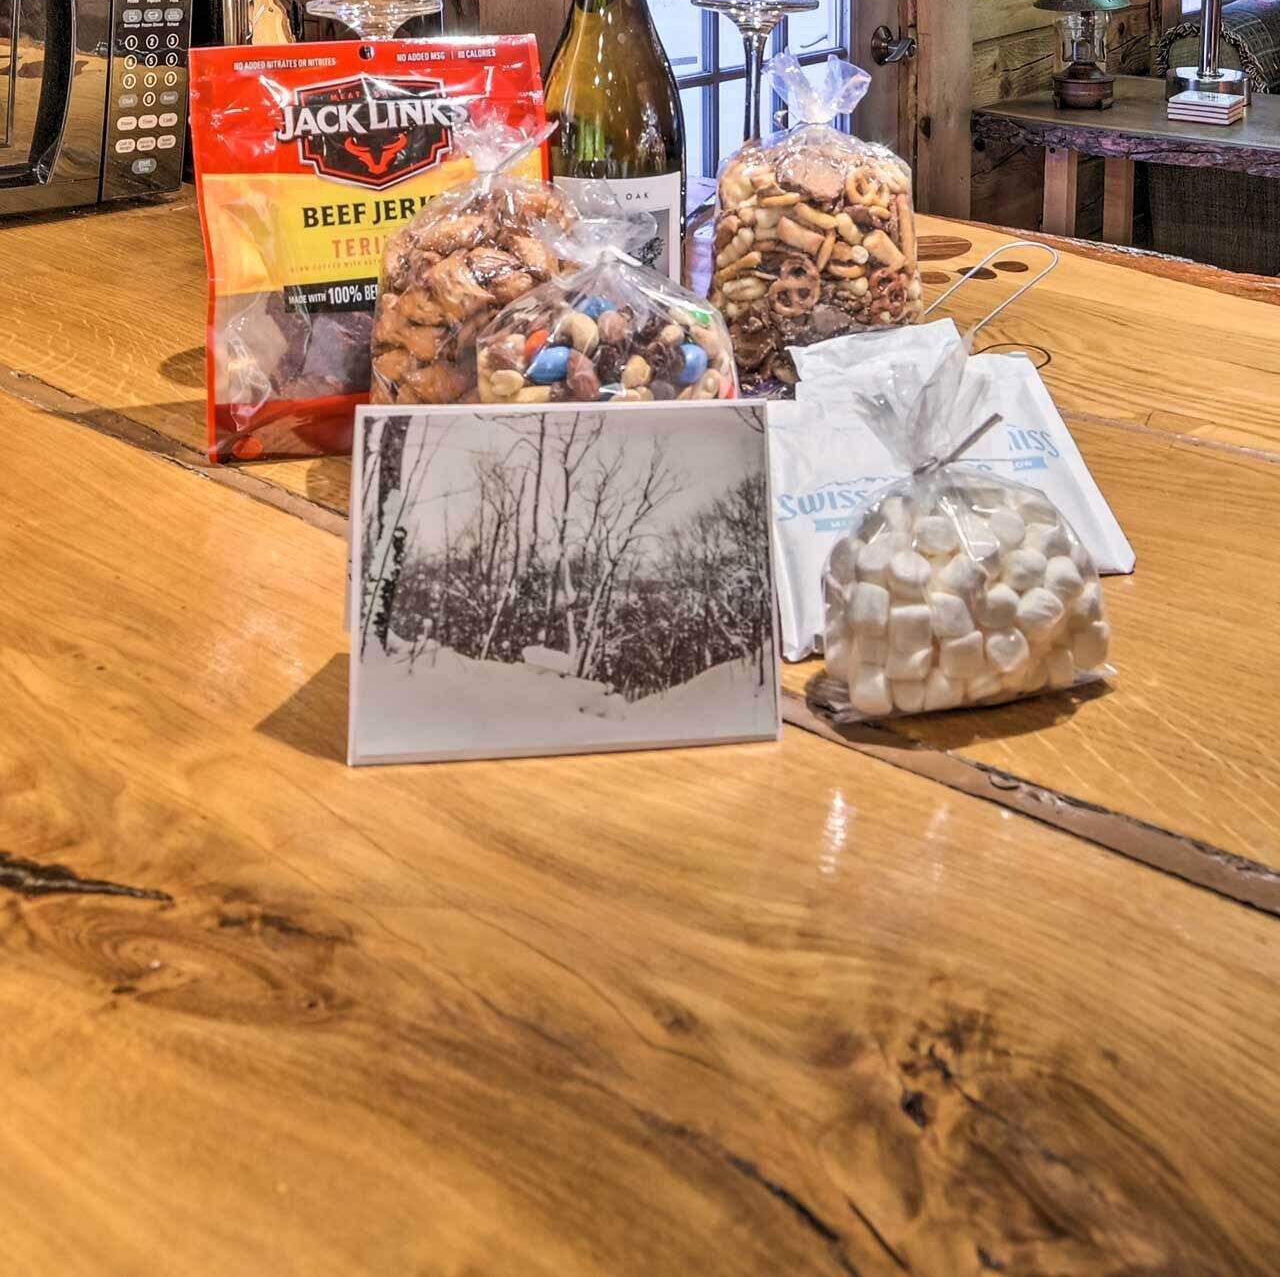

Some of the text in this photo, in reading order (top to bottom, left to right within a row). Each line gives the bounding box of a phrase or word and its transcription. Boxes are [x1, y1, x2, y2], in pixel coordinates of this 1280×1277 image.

[396, 50, 446, 62] NO ADDED MSG
[466, 48, 497, 59] CALORIES
[233, 57, 337, 71] NO ADDED NITRATES OR NITRITES
[330, 90, 361, 102] MEAT
[277, 104, 370, 142] JACK
[626, 191, 649, 201] OAK
[302, 202, 366, 229] BEEF
[332, 234, 387, 260] TERI
[288, 293, 308, 305] MADE
[308, 291, 327, 304] WITH
[327, 283, 363, 306] 100%
